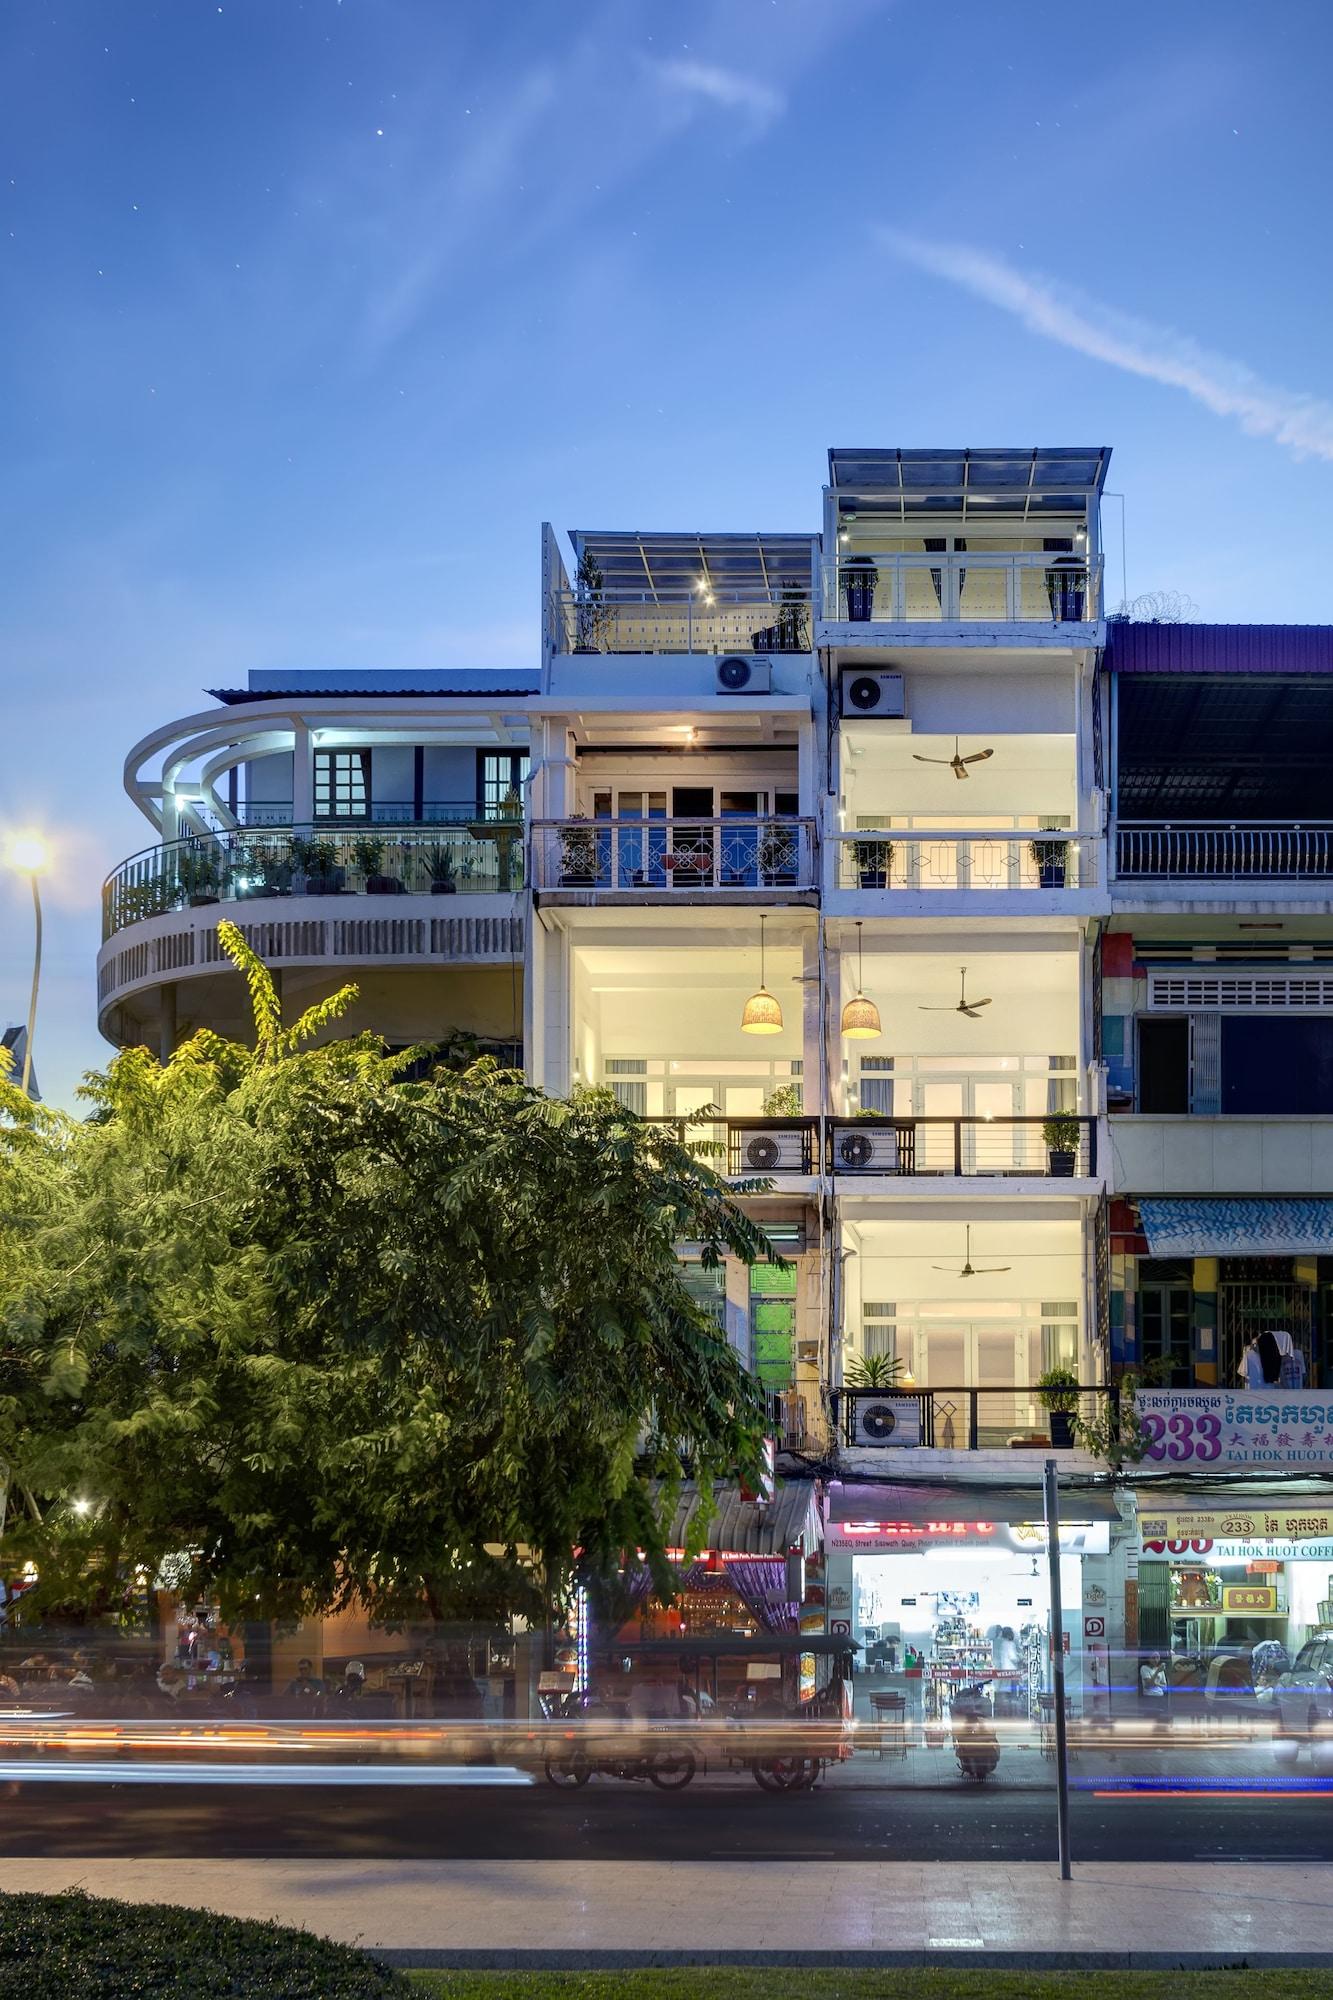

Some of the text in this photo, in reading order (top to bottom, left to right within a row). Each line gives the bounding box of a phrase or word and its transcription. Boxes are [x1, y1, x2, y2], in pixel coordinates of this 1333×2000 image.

[1141, 1414, 1222, 1461] 233
[1226, 1450, 1248, 1460] TAI
[1253, 1450, 1282, 1460] HOK
[1287, 1450, 1325, 1460] HUOT
[1226, 1522, 1251, 1532] 233
[1217, 1546, 1235, 1556] TAI
[1236, 1546, 1263, 1556] HOK
[1266, 1546, 1298, 1556] HUOT
